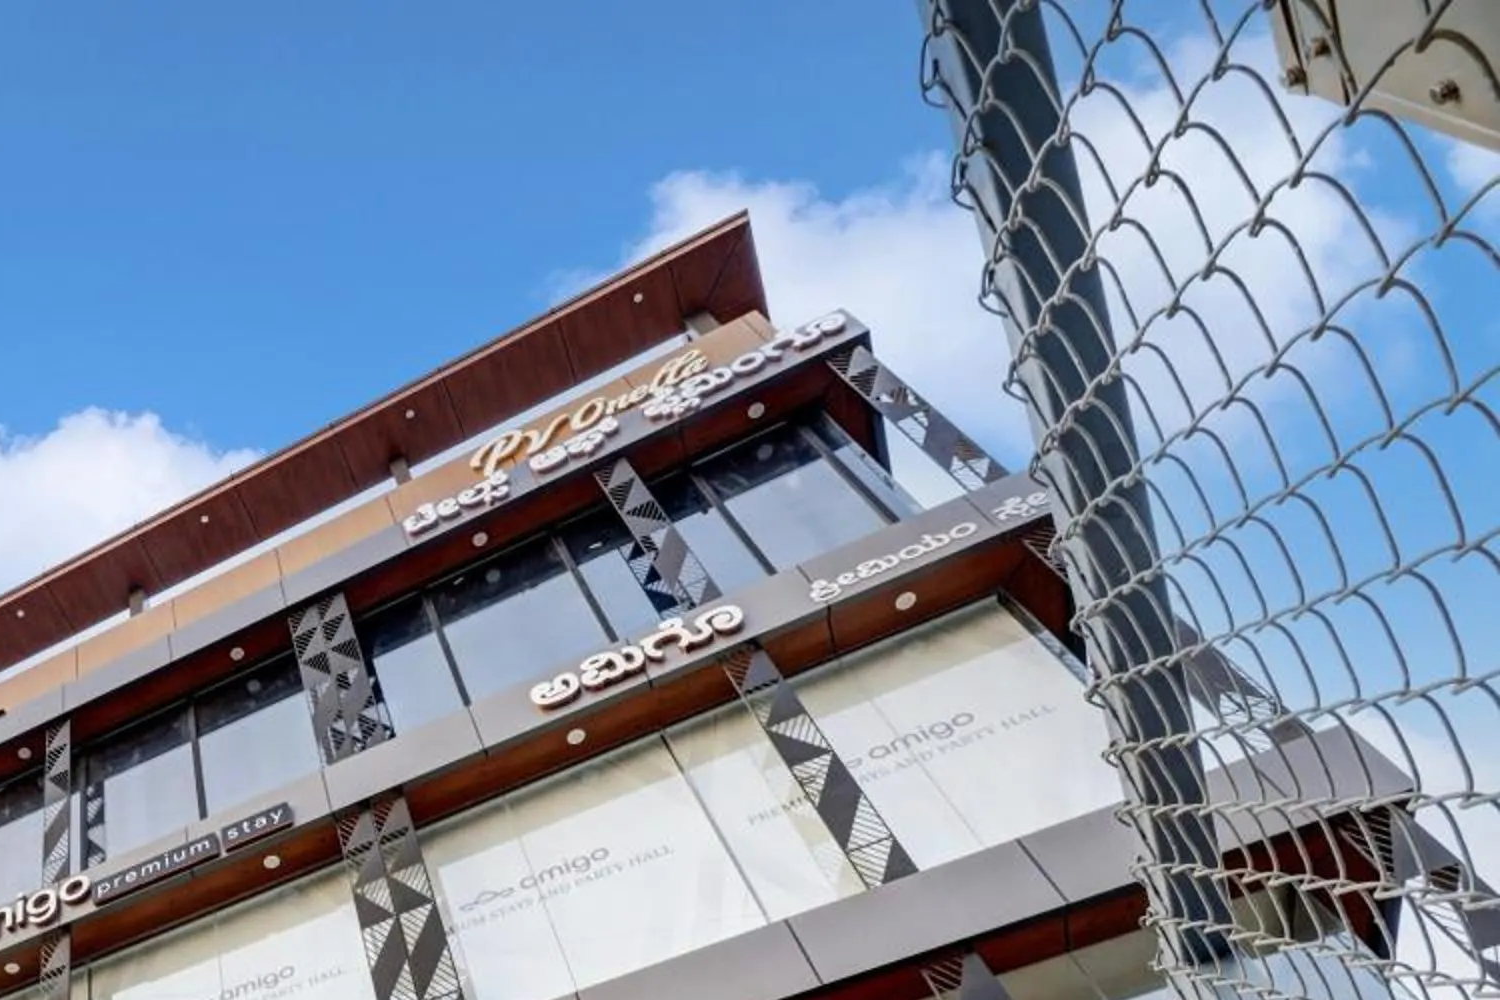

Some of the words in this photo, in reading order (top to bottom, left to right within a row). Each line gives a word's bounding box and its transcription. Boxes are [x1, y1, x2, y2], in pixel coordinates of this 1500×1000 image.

[868, 712, 976, 762] amigo
[96, 839, 211, 898] premium
[226, 808, 285, 842] stay
[519, 847, 611, 891] amigo
[217, 966, 297, 1000] amigo
